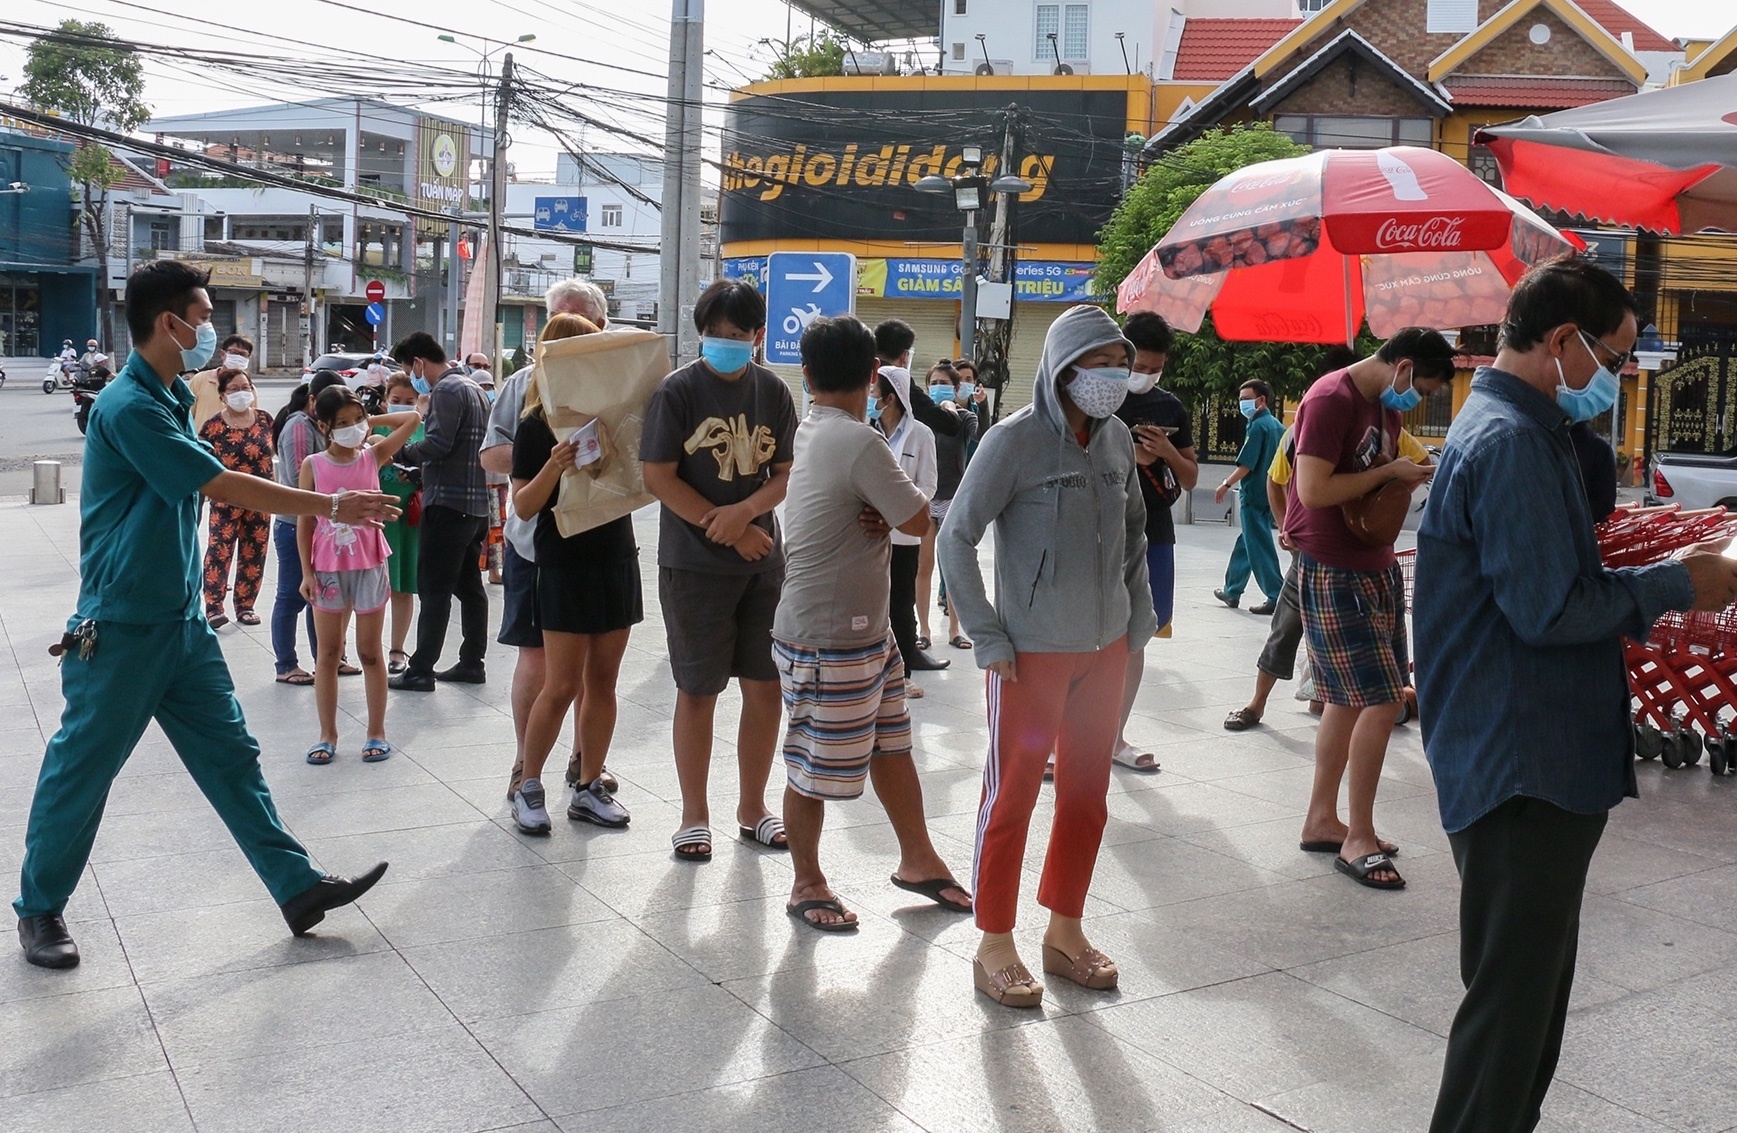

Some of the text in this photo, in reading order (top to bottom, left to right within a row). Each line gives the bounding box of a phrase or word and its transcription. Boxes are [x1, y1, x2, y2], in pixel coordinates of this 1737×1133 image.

[1375, 217, 1466, 249] Coca-Cola
[898, 263, 947, 274] SAMSUNG
[1016, 265, 1044, 276] eries
[1046, 266, 1061, 276] 5G
[897, 274, 963, 292] GIẢM SÂ
[1015, 278, 1064, 297] TRIỆU
[775, 339, 789, 350] BÃI
[1367, 854, 1384, 863] NIKE
